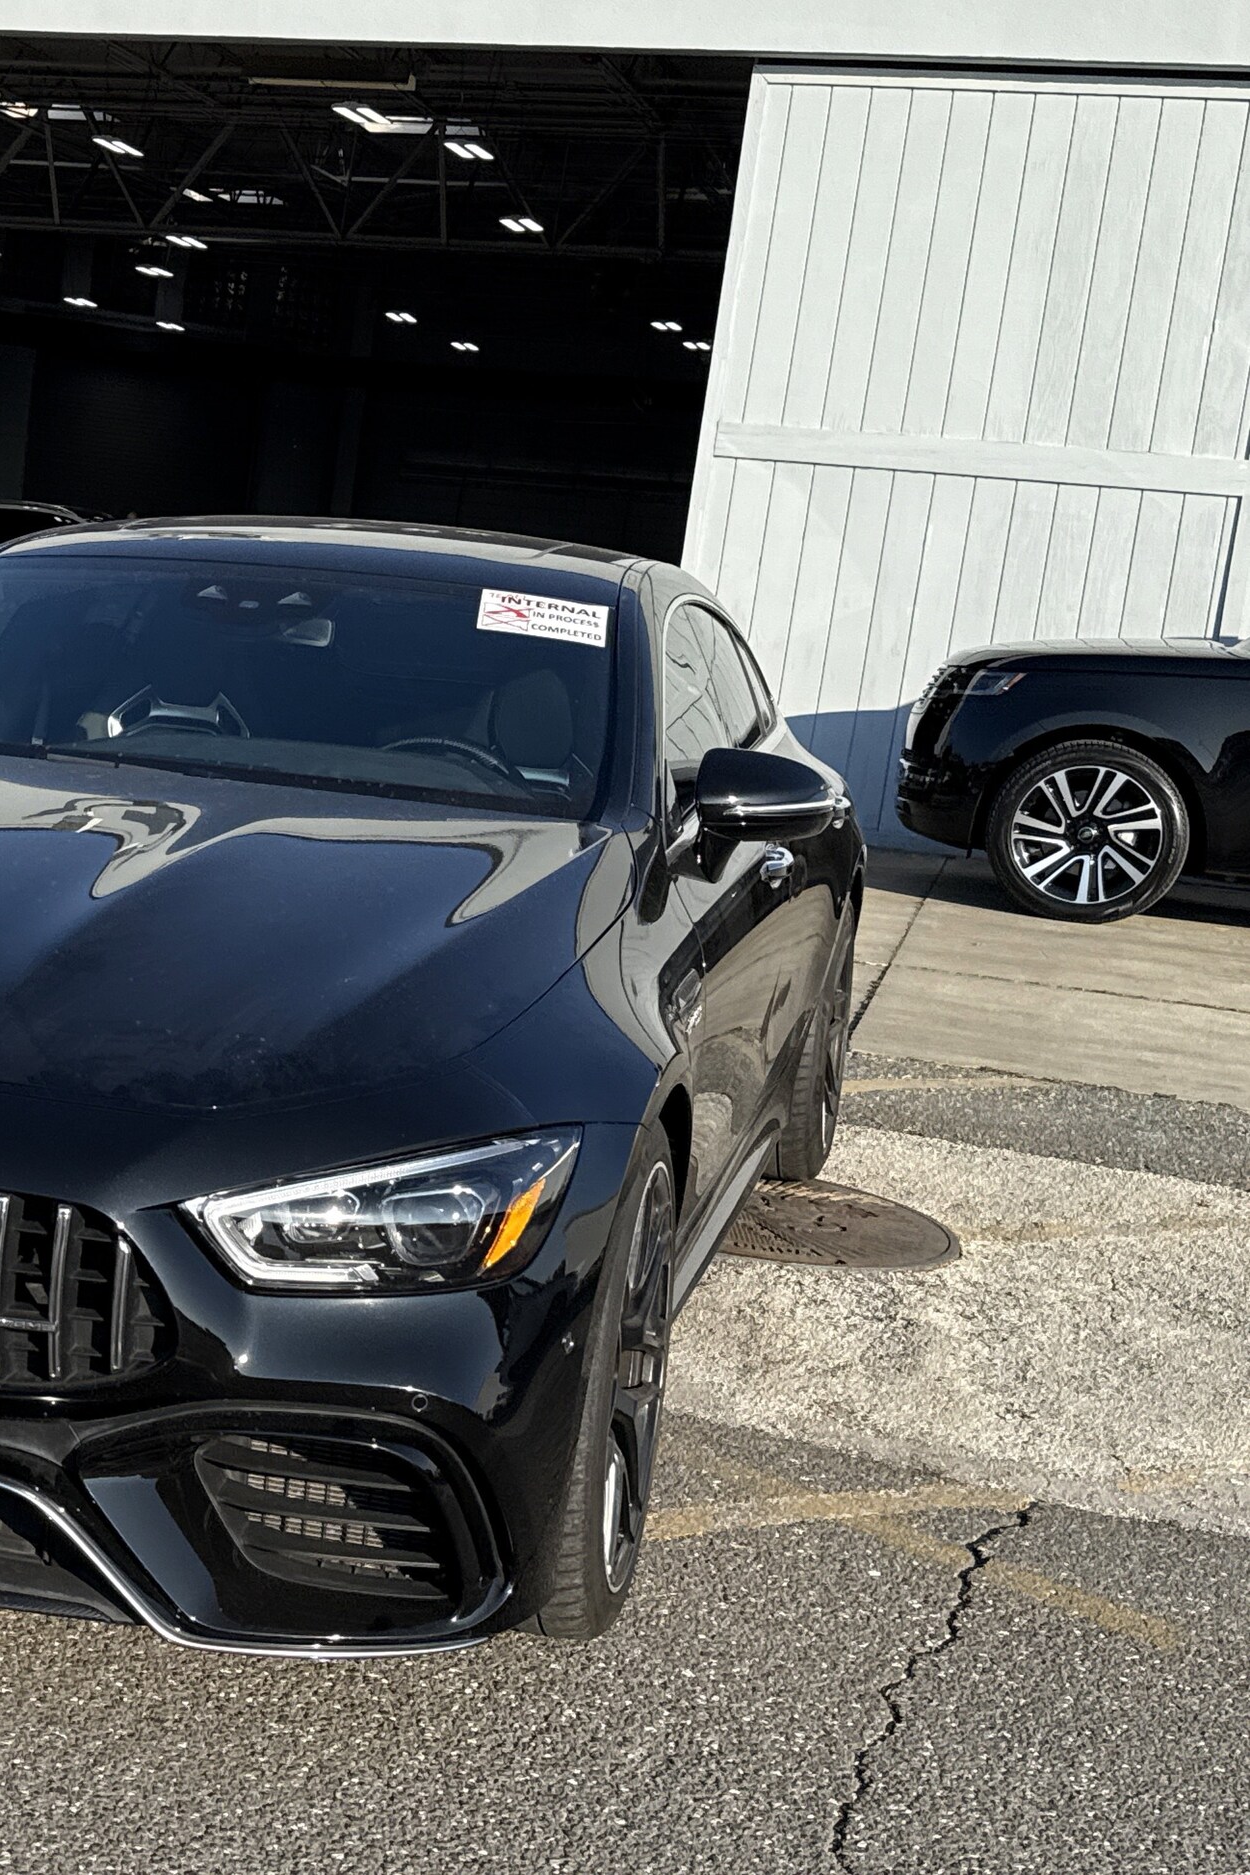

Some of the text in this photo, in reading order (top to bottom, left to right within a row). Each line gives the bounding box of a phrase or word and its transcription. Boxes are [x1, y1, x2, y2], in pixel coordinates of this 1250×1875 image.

[501, 596, 601, 619] INTERNAL
[533, 611, 599, 628] IN PROCESS
[531, 623, 602, 641] COMPLETED
